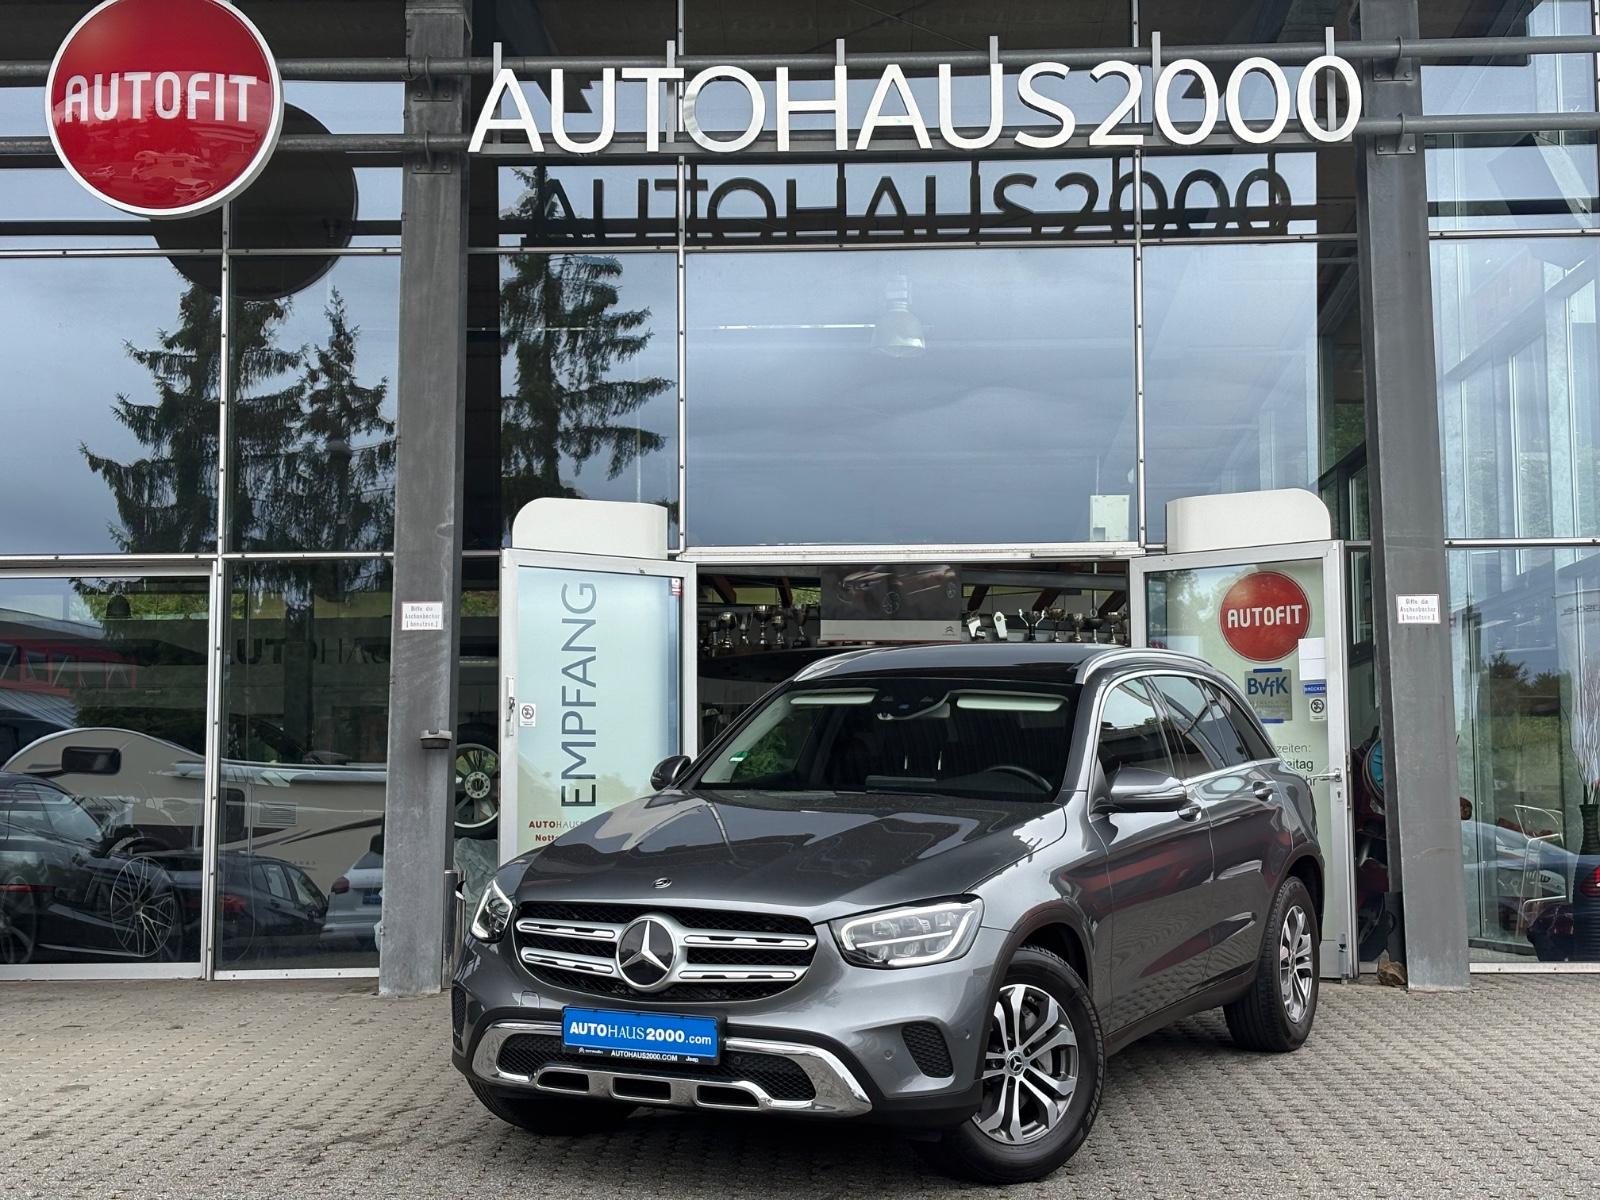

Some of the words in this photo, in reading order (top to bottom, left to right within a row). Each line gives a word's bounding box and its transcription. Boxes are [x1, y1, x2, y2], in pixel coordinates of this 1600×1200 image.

[65, 71, 258, 122] AUTOFIT
[467, 55, 1362, 154] AUTOHAUS2000
[1227, 604, 1302, 629] AUTOFIT
[560, 583, 597, 807] EMPFANG
[1247, 676, 1289, 697] BvfK
[1276, 744, 1312, 753] zeiten:
[1286, 758, 1314, 772] eitag
[1305, 775, 1317, 786] hr
[535, 833, 557, 842] Nott
[610, 1049, 678, 1062] AUTOHAUS2000.COM
[685, 1055, 699, 1063] Jeep
